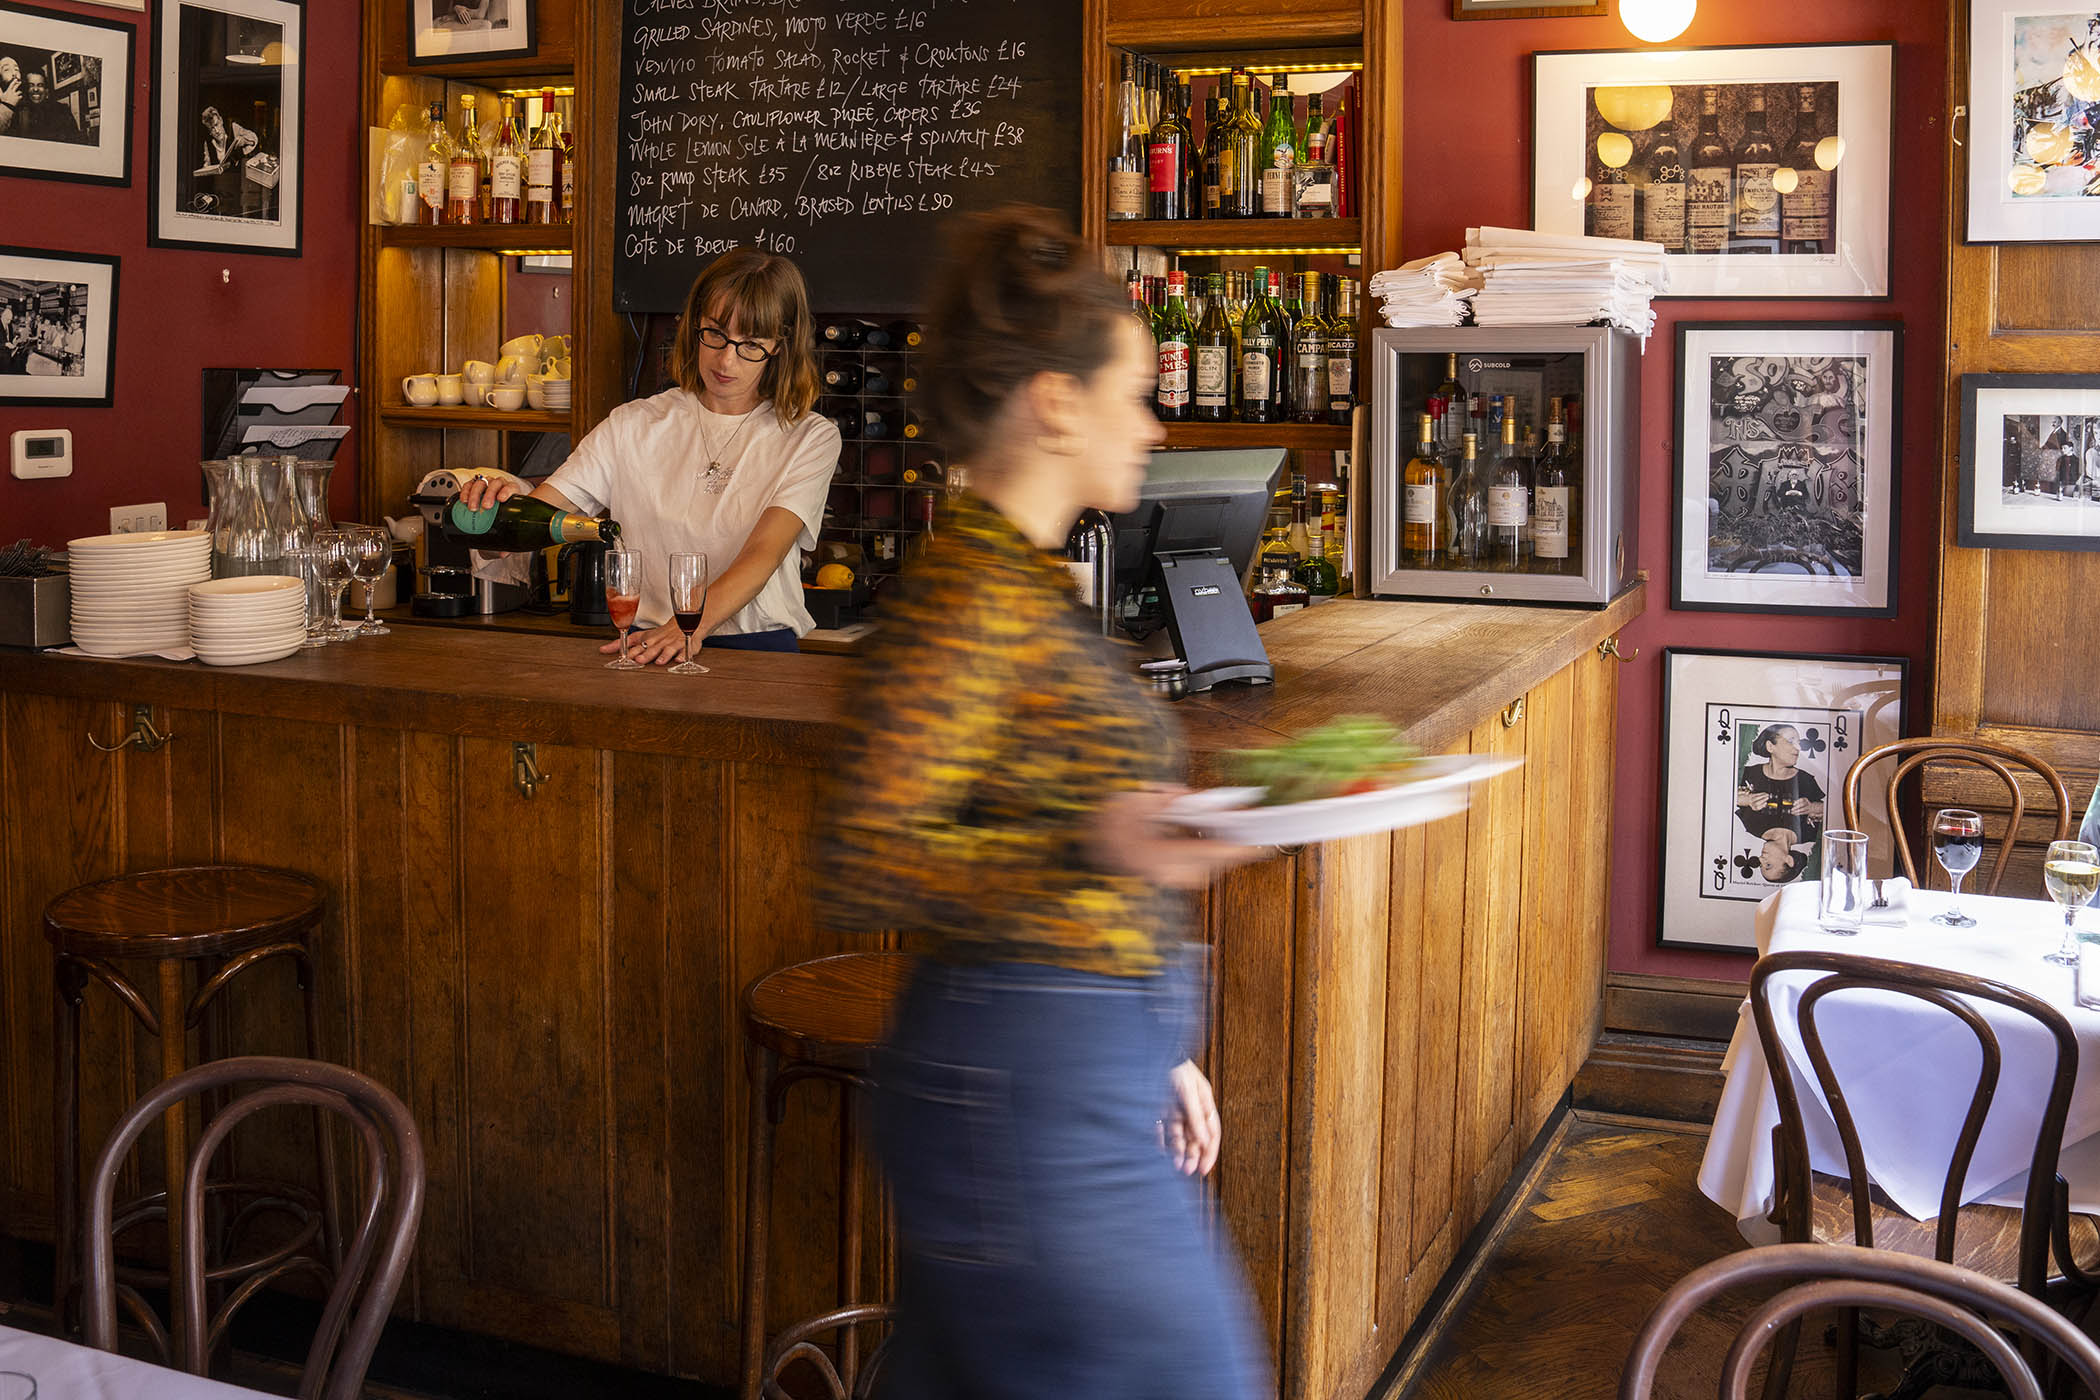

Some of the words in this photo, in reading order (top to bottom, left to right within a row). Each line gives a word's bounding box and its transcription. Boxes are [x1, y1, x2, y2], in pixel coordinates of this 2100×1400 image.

[633, 25, 691, 56] GRILLED
[694, 16, 778, 43] SARDINES,
[785, 16, 827, 51] MOJO
[835, 12, 888, 36] VERDE
[895, 8, 928, 31] £16
[704, 44, 765, 75] TOMATO
[773, 49, 826, 73] SALAD,
[831, 42, 890, 76] ROCKET
[914, 39, 990, 69] CROUTONS
[998, 39, 1027, 61] £16
[632, 83, 681, 105] SMALL
[688, 80, 740, 103] STEAK
[749, 74, 811, 104] TARTARE
[861, 80, 909, 107] LARGE
[918, 73, 981, 101] TARTARE
[986, 74, 1023, 100] £24
[627, 110, 674, 142] JOHN
[676, 110, 725, 136] DORY,
[732, 106, 829, 132] CAULIFLOWER
[882, 105, 940, 129] CAPERS
[949, 99, 983, 120] £36
[628, 141, 677, 169] WHOLE
[684, 137, 732, 164] LEMON
[736, 133, 771, 160] SOLE
[792, 131, 808, 153] LA
[918, 128, 991, 156] SPINACH
[993, 121, 1025, 148] £38
[660, 171, 697, 201] RUMP
[702, 161, 751, 193] STEAK
[758, 163, 789, 185] £35
[847, 159, 903, 194] RIBEYE
[907, 155, 957, 185] STEAK
[958, 156, 1001, 179] £45
[627, 196, 694, 234] MAGRET
[700, 203, 720, 219] DE
[729, 196, 789, 222] CANARD,
[797, 195, 855, 227] BRAISED
[861, 191, 915, 216] LENTILS
[918, 192, 954, 213] £90
[624, 230, 658, 265] COTE
[664, 238, 686, 256] DE
[694, 235, 739, 257] BOEUF
[1159, 351, 1184, 364] PUNT
[1163, 359, 1188, 371] MES
[1297, 343, 1328, 353] CAMPA
[1717, 708, 1732, 730] Q
[1834, 714, 1848, 737] Q
[1713, 870, 1727, 891] Q
